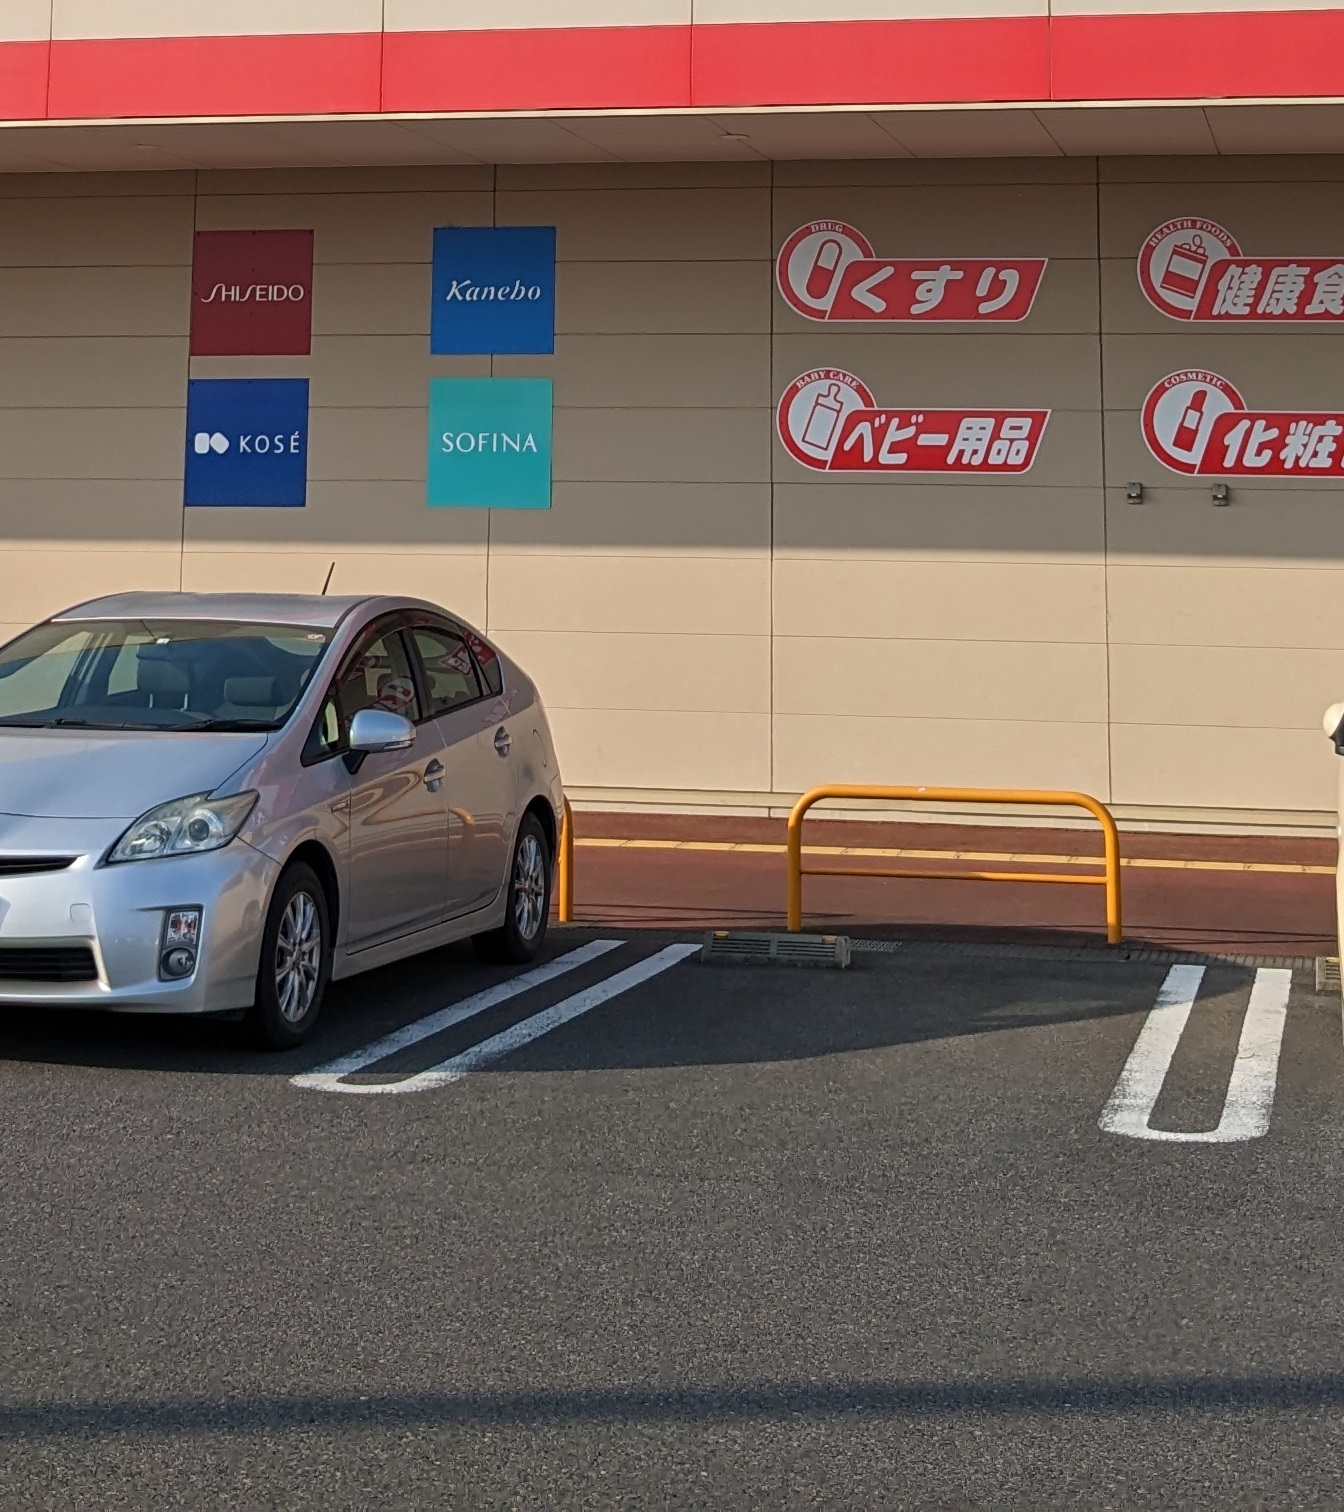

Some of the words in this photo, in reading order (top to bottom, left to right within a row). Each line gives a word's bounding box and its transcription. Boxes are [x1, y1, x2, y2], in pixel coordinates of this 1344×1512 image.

[809, 220, 845, 234] DRUG
[1148, 221, 1192, 248] HEALTH
[1194, 219, 1233, 248] FOODS
[200, 282, 304, 303] SHISEIDO
[445, 279, 542, 303] Kanebo
[851, 265, 1021, 315] くすり
[795, 371, 827, 390] BABY
[829, 371, 860, 390] CARE
[1163, 373, 1226, 389] COSMETIC
[239, 431, 301, 454] KOSÉ
[441, 432, 538, 454] SOFINA
[843, 414, 1034, 466] ベビー用品
